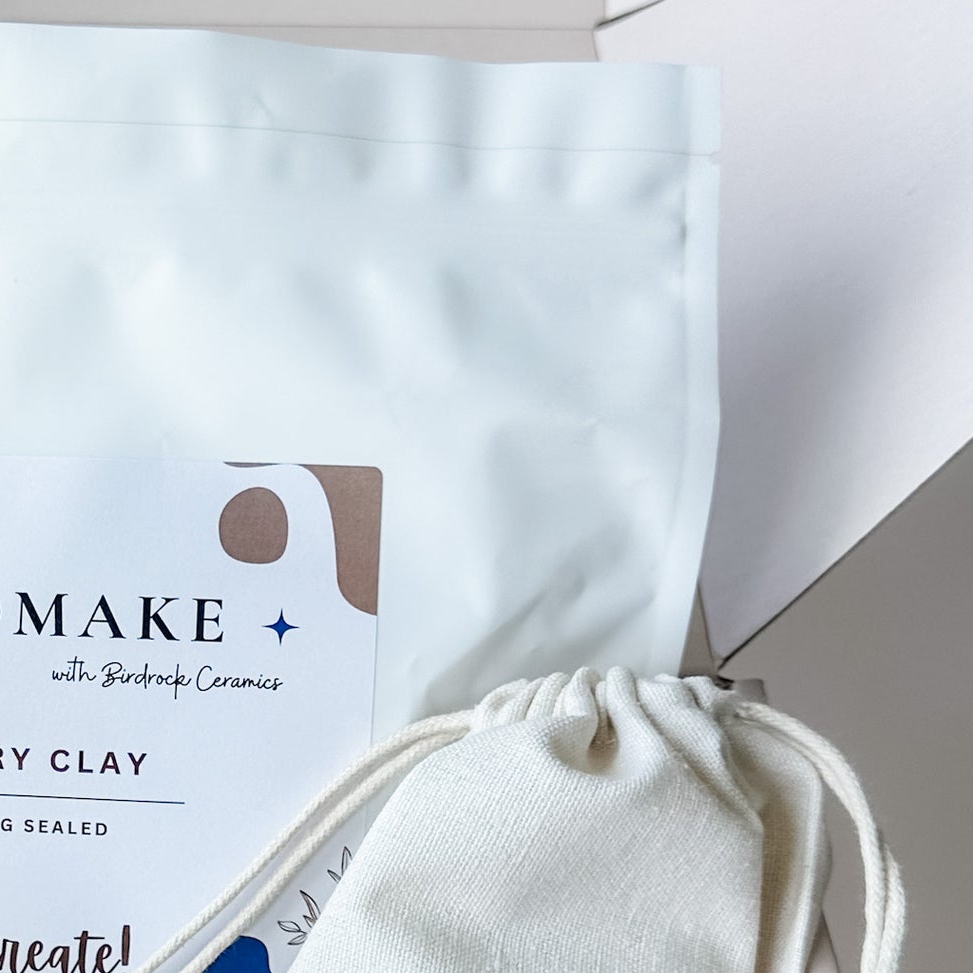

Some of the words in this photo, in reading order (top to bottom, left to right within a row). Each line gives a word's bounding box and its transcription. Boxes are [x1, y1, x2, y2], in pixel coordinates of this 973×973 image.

[51, 655, 97, 682] with
[100, 661, 192, 700] Birdrock
[195, 665, 284, 692] Ceramics
[50, 749, 148, 776] CLAY
[23, 819, 108, 836] SEALED
